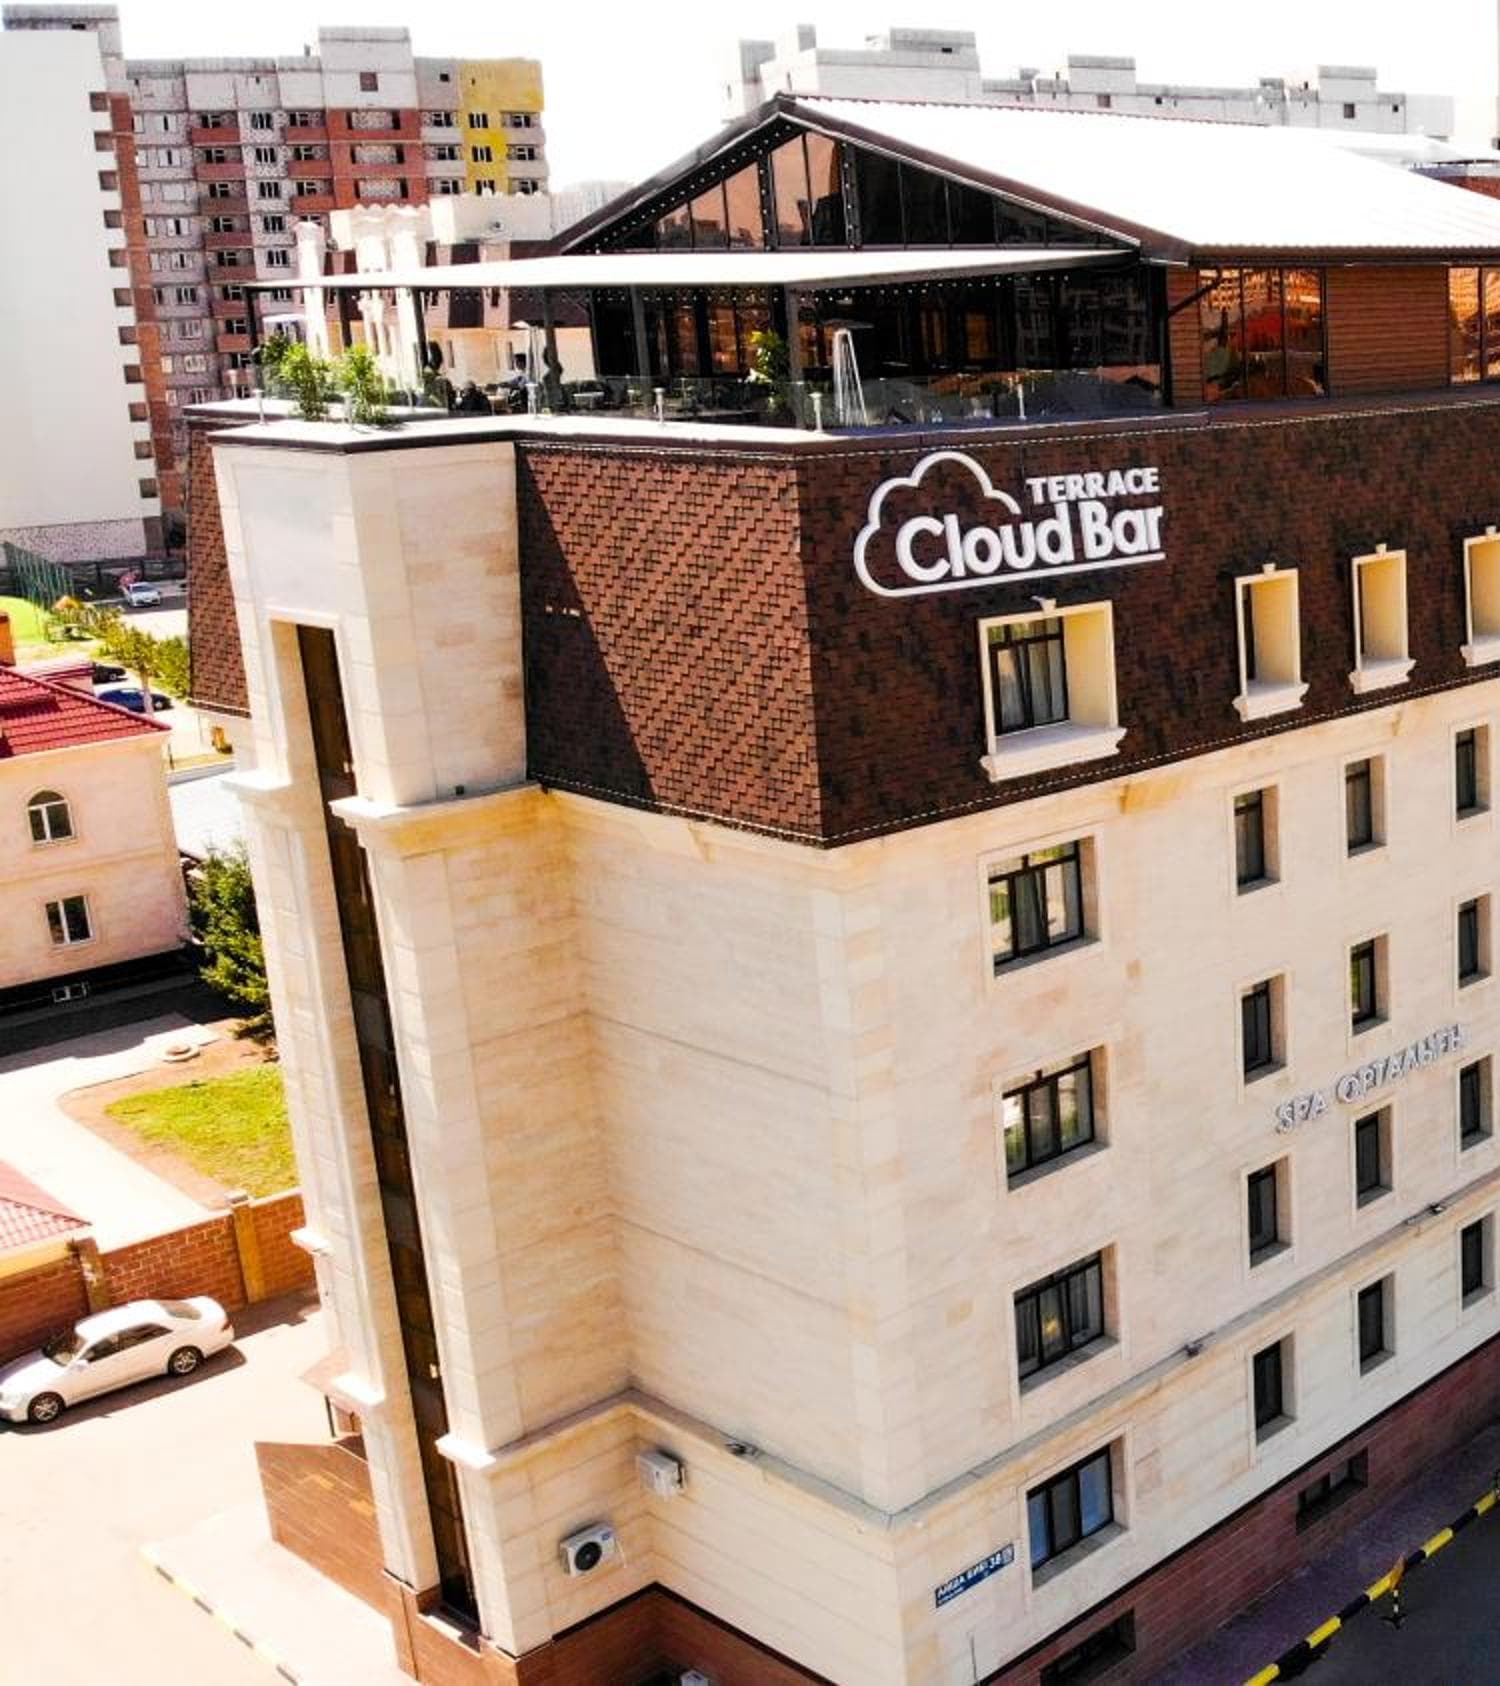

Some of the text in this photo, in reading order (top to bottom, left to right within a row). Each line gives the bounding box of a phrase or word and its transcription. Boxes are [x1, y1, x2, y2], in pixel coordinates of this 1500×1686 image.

[1026, 467, 1160, 505] TERRACE
[895, 500, 1164, 582] Cloud Bar
[1275, 1090, 1329, 1135] SPA
